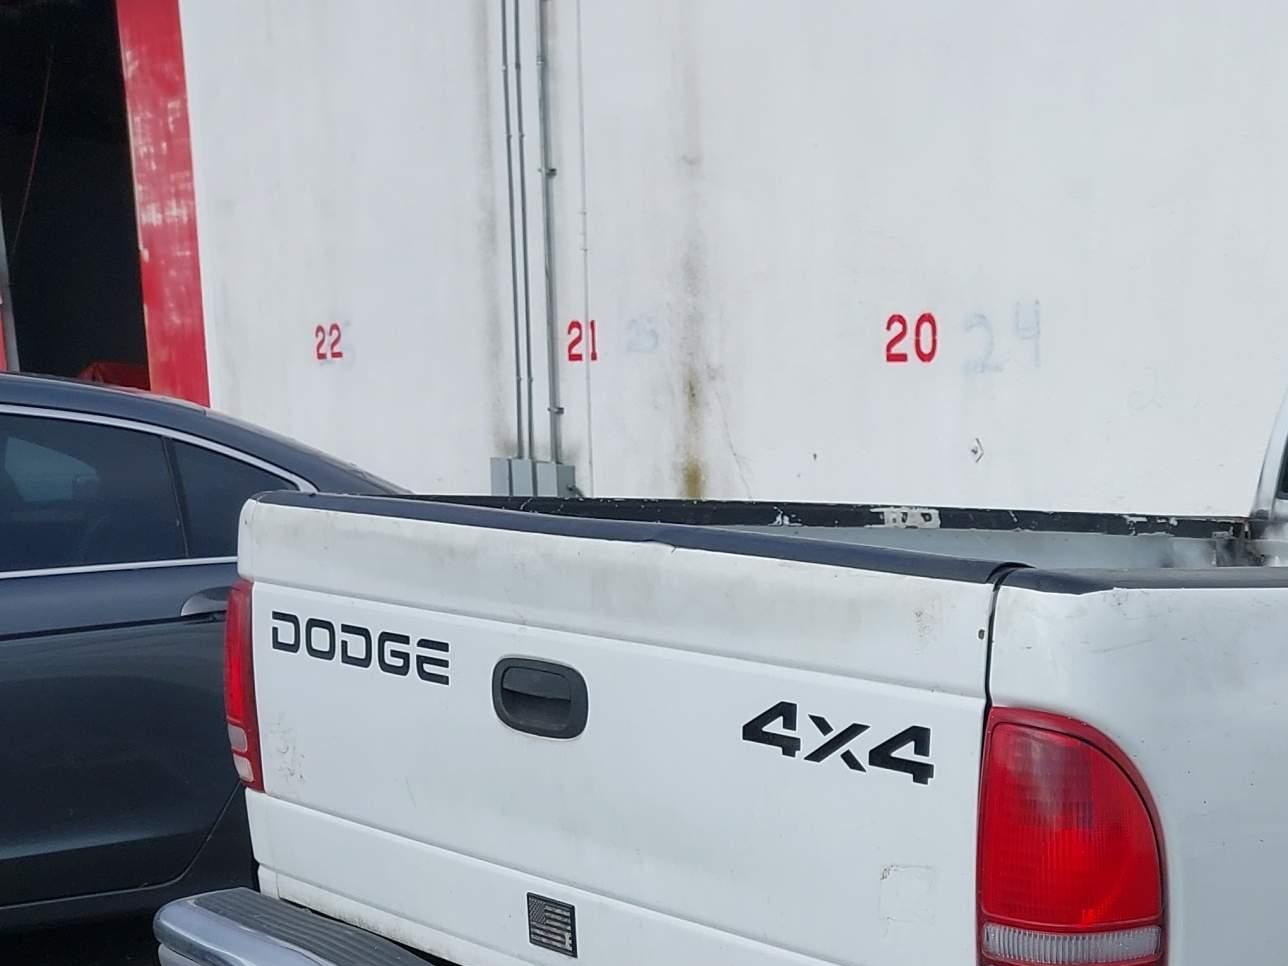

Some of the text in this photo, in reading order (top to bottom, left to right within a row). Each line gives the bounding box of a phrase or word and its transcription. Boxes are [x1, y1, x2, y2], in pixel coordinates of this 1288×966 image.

[314, 323, 343, 360] 22
[567, 320, 598, 361] 21
[886, 312, 938, 362] 20
[271, 610, 450, 686] DODGE
